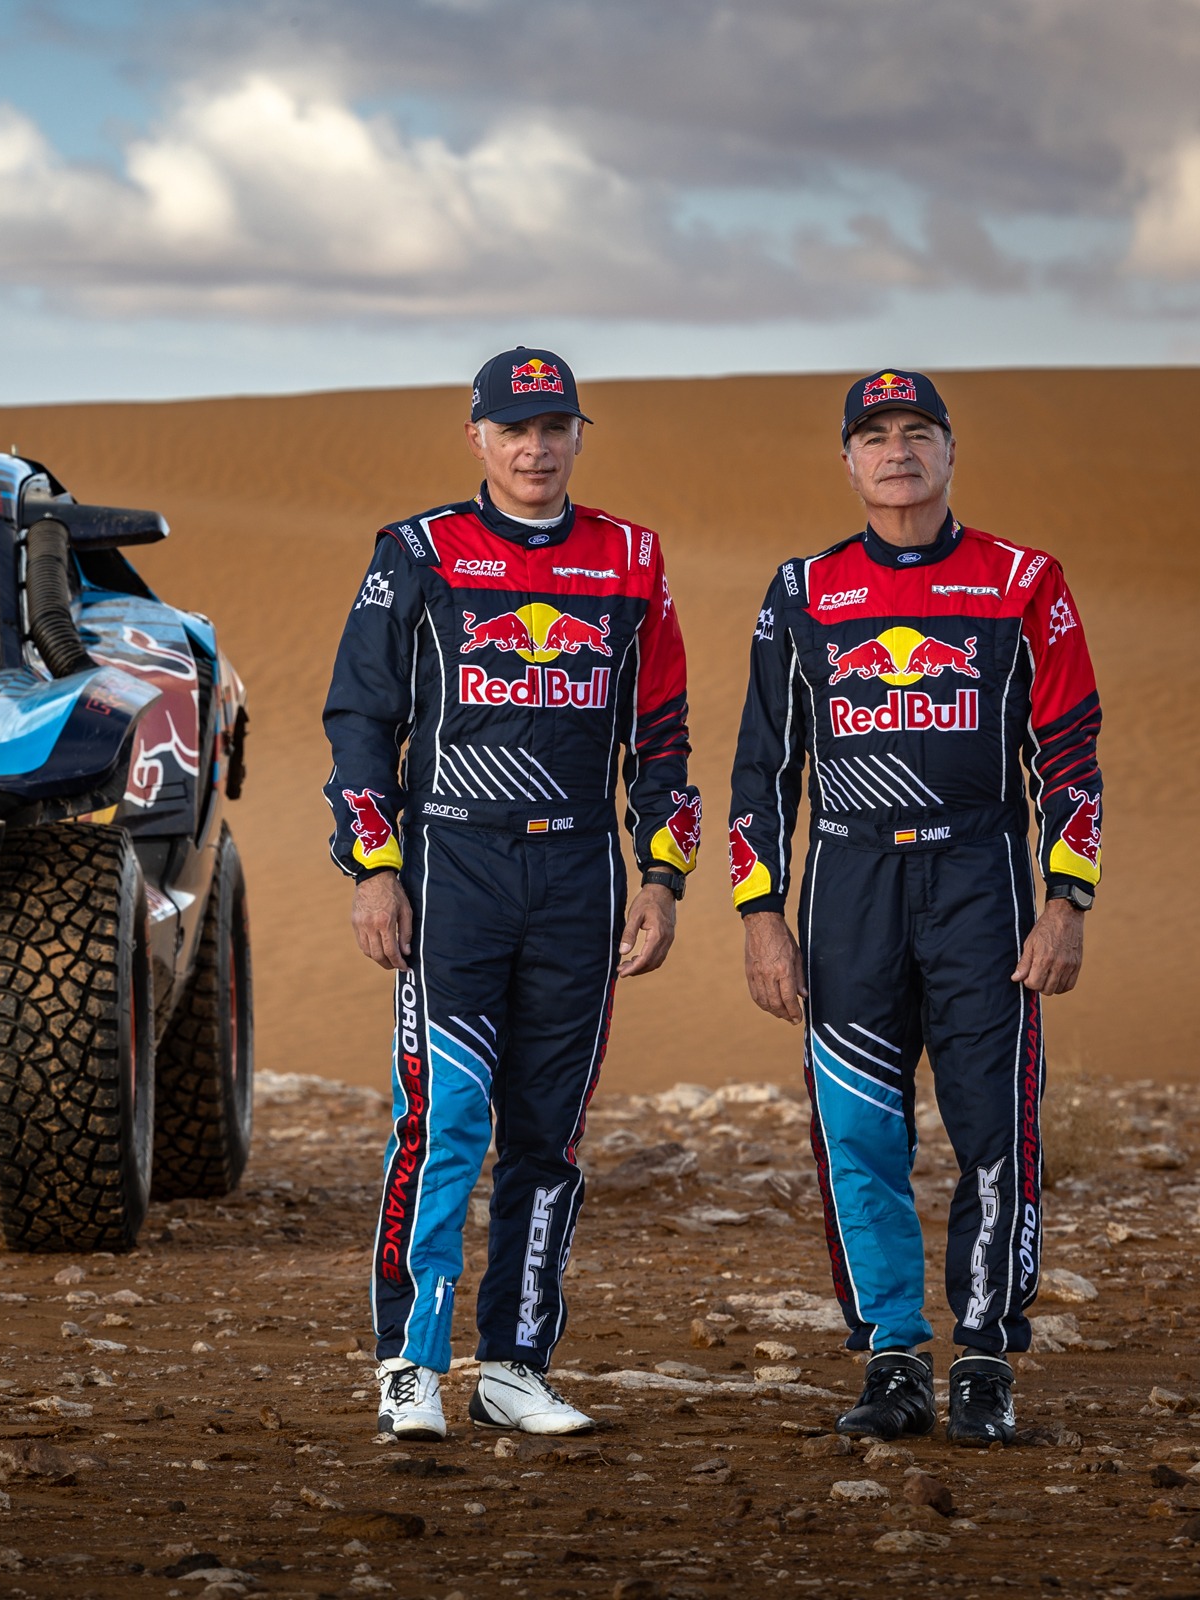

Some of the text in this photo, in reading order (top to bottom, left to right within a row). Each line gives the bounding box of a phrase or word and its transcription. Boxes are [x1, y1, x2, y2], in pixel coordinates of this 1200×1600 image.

[511, 379, 564, 394] Red Bull
[862, 388, 917, 407] Red Bull
[399, 524, 426, 558] sparco
[638, 531, 652, 567] sparco
[452, 567, 506, 577] PERFORMANCE
[455, 558, 507, 571] FORD
[552, 566, 620, 580] RAPTOR
[1018, 555, 1047, 588] sparco
[782, 563, 799, 596] sparco
[820, 587, 869, 605] FORD
[931, 584, 1003, 601] RAPTOR
[458, 663, 612, 709] Red Bull
[829, 688, 979, 738] Red Bull
[422, 802, 469, 820] sparco
[551, 817, 575, 831] CRUZ
[818, 818, 849, 837] sparco
[920, 826, 952, 841] SAINZ
[401, 968, 419, 1054] FORD
[1019, 992, 1039, 1292] FORD PERFORMAN
[963, 1156, 1007, 1330] RAPTOR
[516, 1180, 569, 1348] RAPTOR
